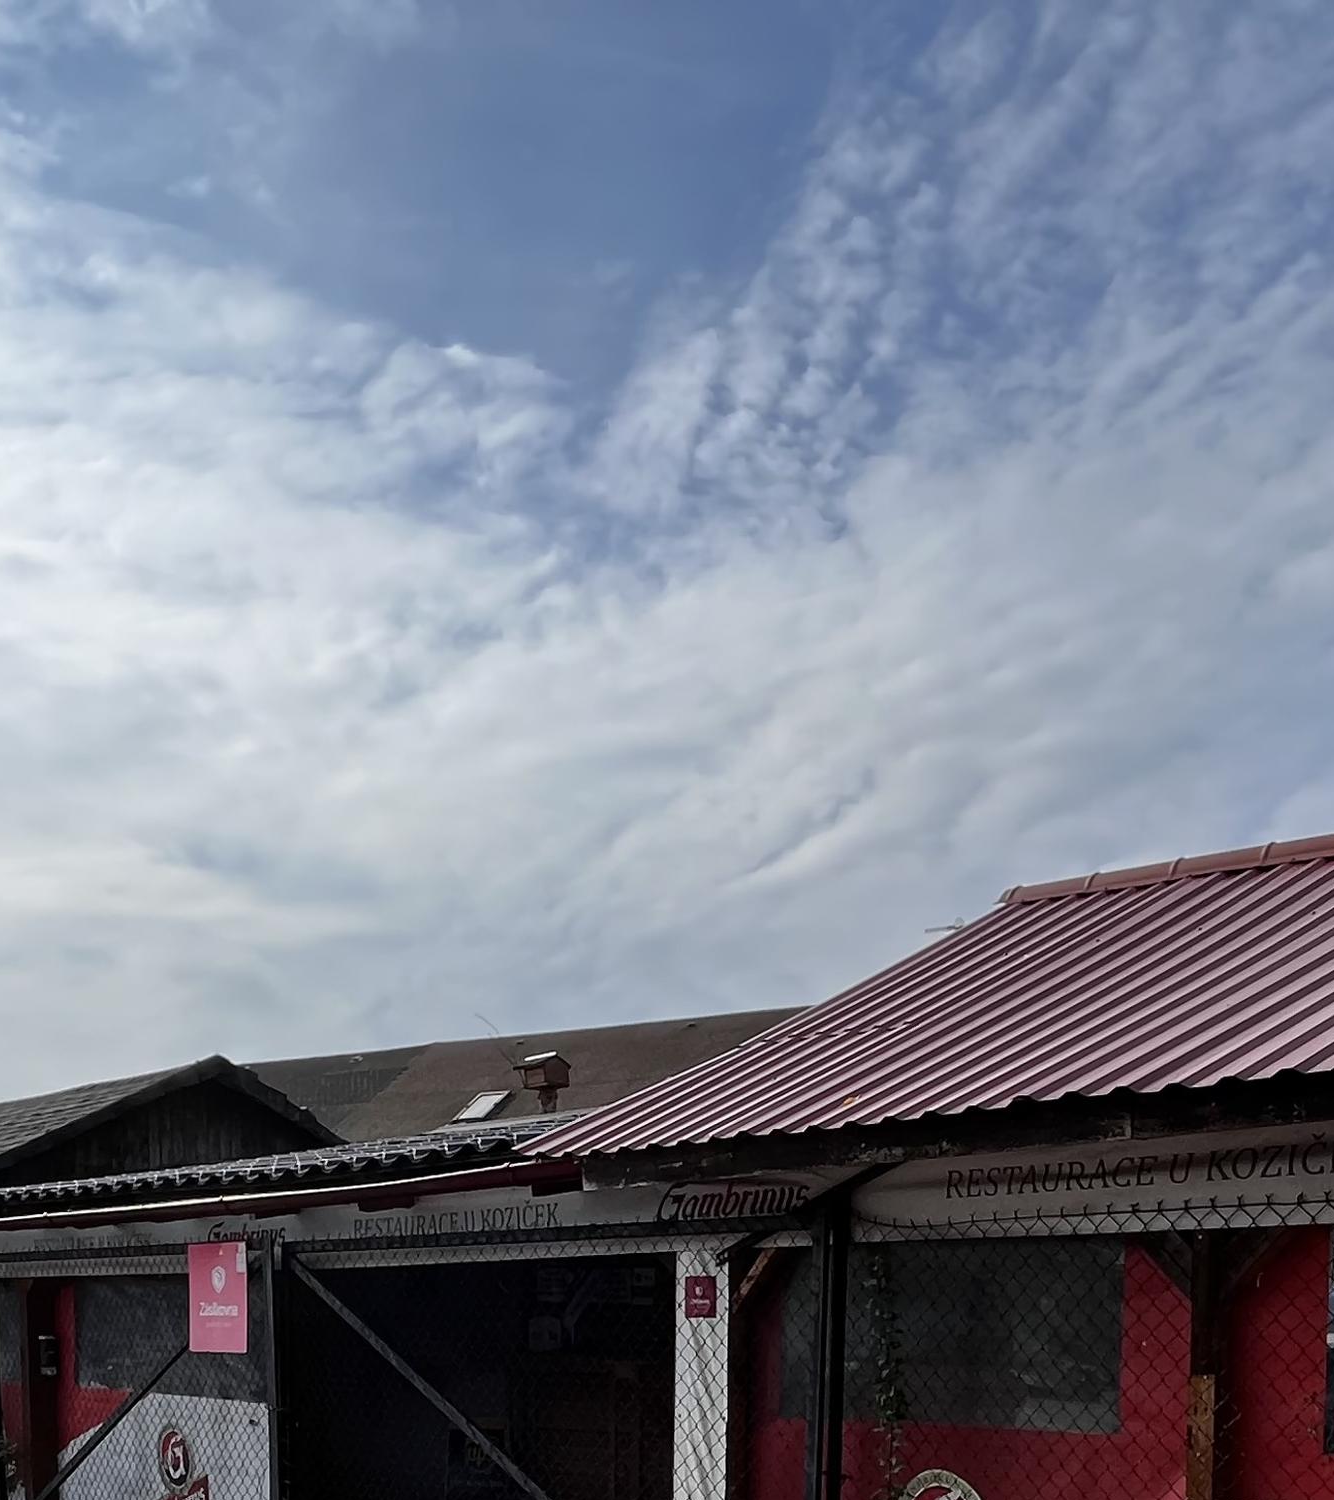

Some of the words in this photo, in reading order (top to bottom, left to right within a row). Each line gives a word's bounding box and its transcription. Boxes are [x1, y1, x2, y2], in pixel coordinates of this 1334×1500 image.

[945, 1155, 1158, 1199] RESTAURACE
[1169, 1152, 1195, 1184] U
[658, 1180, 810, 1223] Gambrinus
[353, 1212, 458, 1238] RESTAURACE
